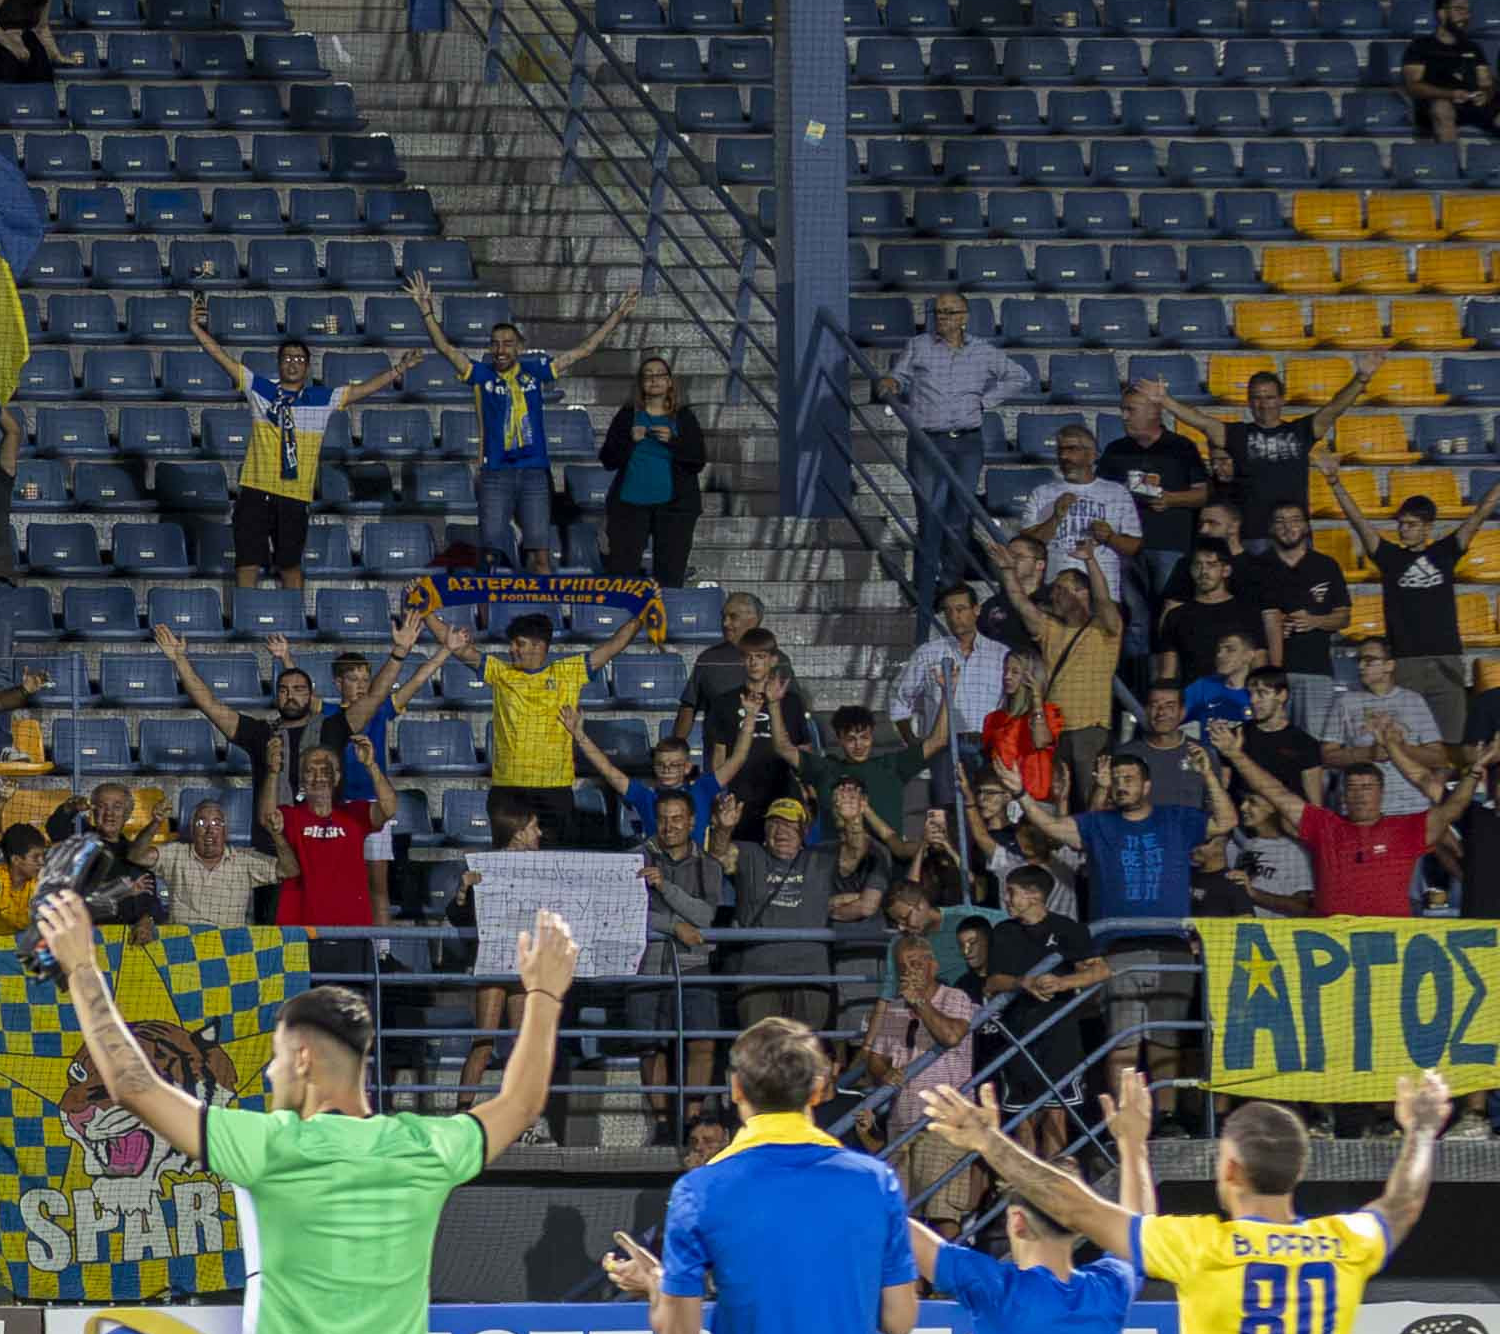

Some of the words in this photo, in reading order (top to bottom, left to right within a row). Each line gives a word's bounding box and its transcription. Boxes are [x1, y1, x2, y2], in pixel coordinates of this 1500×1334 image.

[448, 576, 542, 593] ΑΣΤΕΡΑΣ
[549, 576, 651, 599] ΤΡΙΠΟΛΗΣ
[501, 593, 558, 603] FOOTBALL
[562, 593, 593, 603] CLUB
[1223, 923, 1499, 1072] ΑΡΓΟΣ
